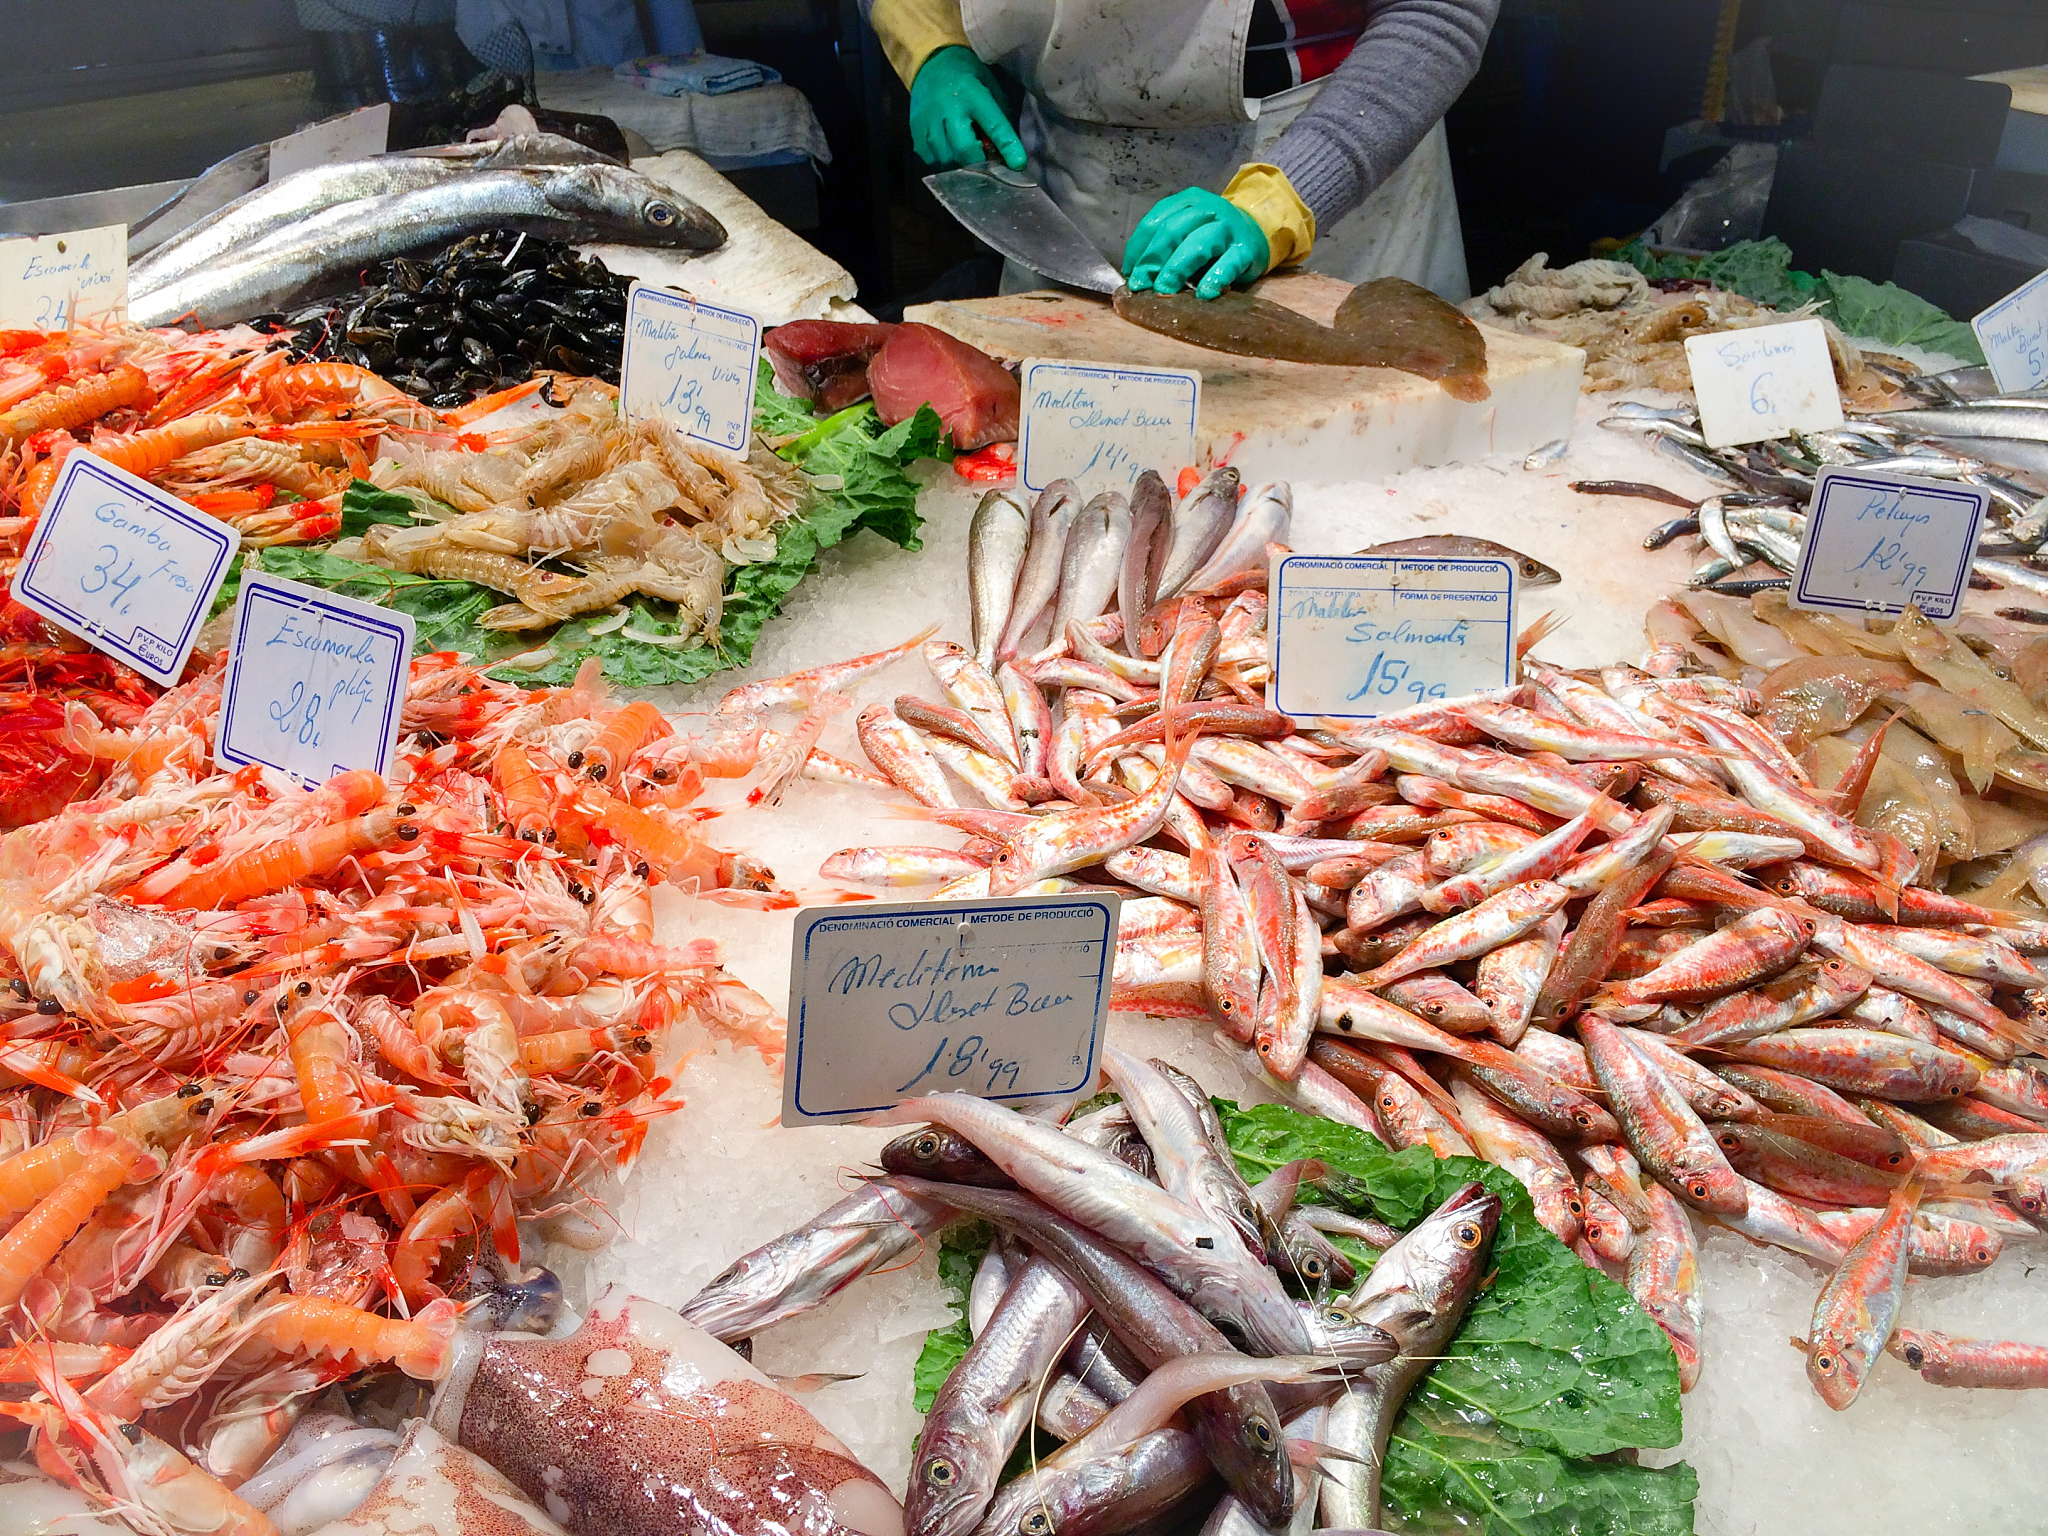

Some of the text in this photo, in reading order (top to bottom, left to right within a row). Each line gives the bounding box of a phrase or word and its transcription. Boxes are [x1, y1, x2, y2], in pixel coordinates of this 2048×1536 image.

[637, 292, 667, 304] DENOMINACIÓ
[696, 307, 715, 318] METODE
[723, 314, 751, 327] PRODUCCIÓ
[1078, 371, 1110, 380] COMERCIAL
[1118, 374, 1187, 387] METODE DE PRODUCCIÓ
[1073, 441, 1152, 483] 14'9
[1288, 561, 1389, 571] DENOMINACIÓ COMERCIAL
[1400, 563, 1499, 573] METODE DE PRODUCCIÓ
[1400, 592, 1498, 602] FORMA DE PRESENTACIÓ
[1934, 596, 1951, 605] KILO
[156, 643, 174, 657] KILO
[970, 907, 1094, 925] METODE DE PRODUCCIÓ
[818, 916, 956, 933] DENOMINACIÓ COMERCIAL
